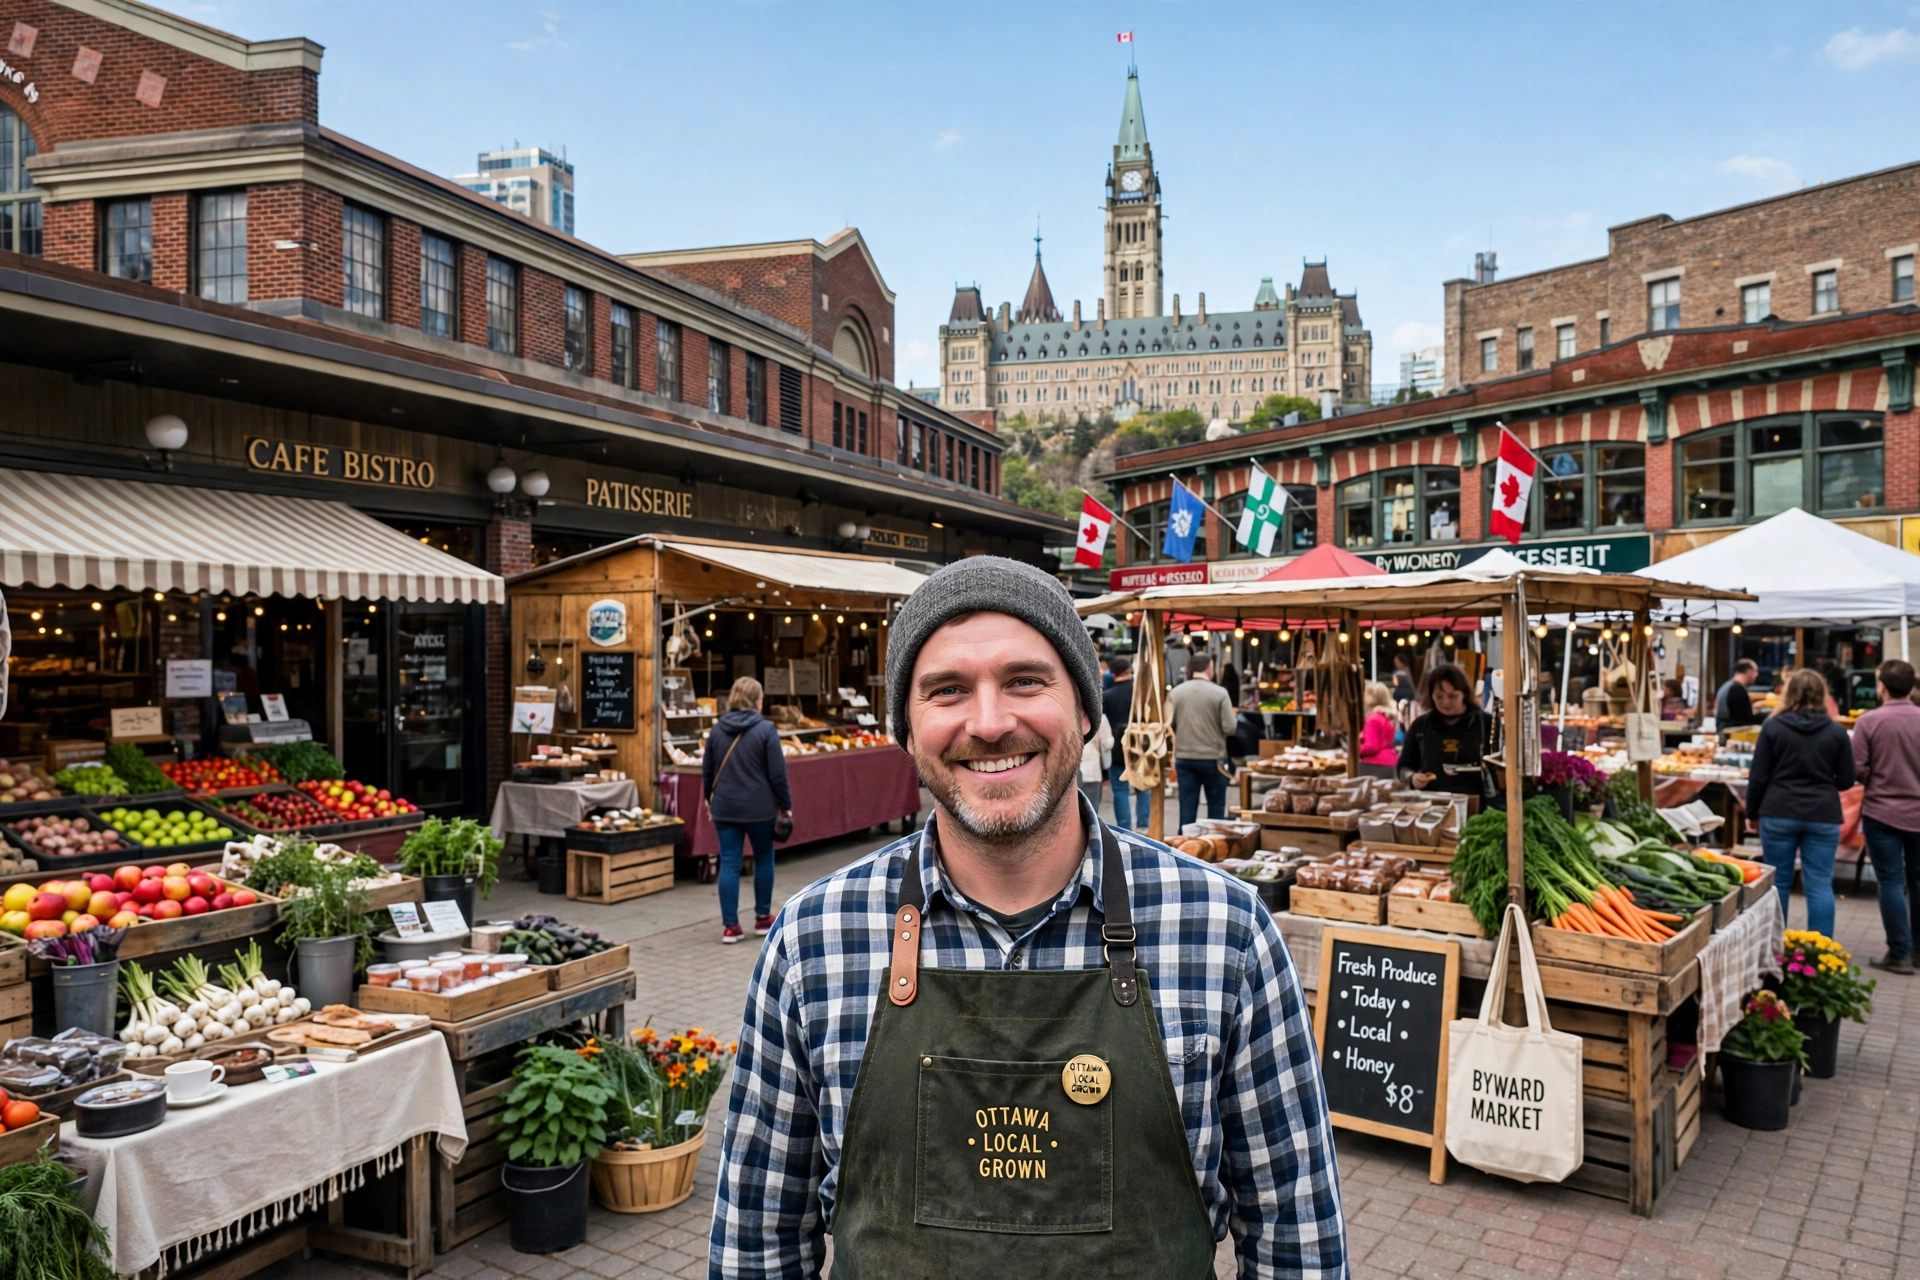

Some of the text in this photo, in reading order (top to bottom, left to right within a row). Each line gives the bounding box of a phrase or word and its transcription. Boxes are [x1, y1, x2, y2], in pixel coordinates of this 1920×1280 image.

[249, 438, 435, 489] CAFE BISTRO
[585, 477, 693, 519] PATISSERIE
[1337, 951, 1438, 986] Fresh Produce
[1351, 984, 1397, 1019] Today
[1349, 1015, 1392, 1043] Local
[1345, 1045, 1395, 1084] Honey
[1472, 1068, 1545, 1103] BYWARD
[975, 1106, 1049, 1132] OTTAWA
[1470, 1096, 1543, 1131] MARKET
[983, 1132, 1042, 1154] LOCAL
[979, 1157, 1046, 1179] GROWN
